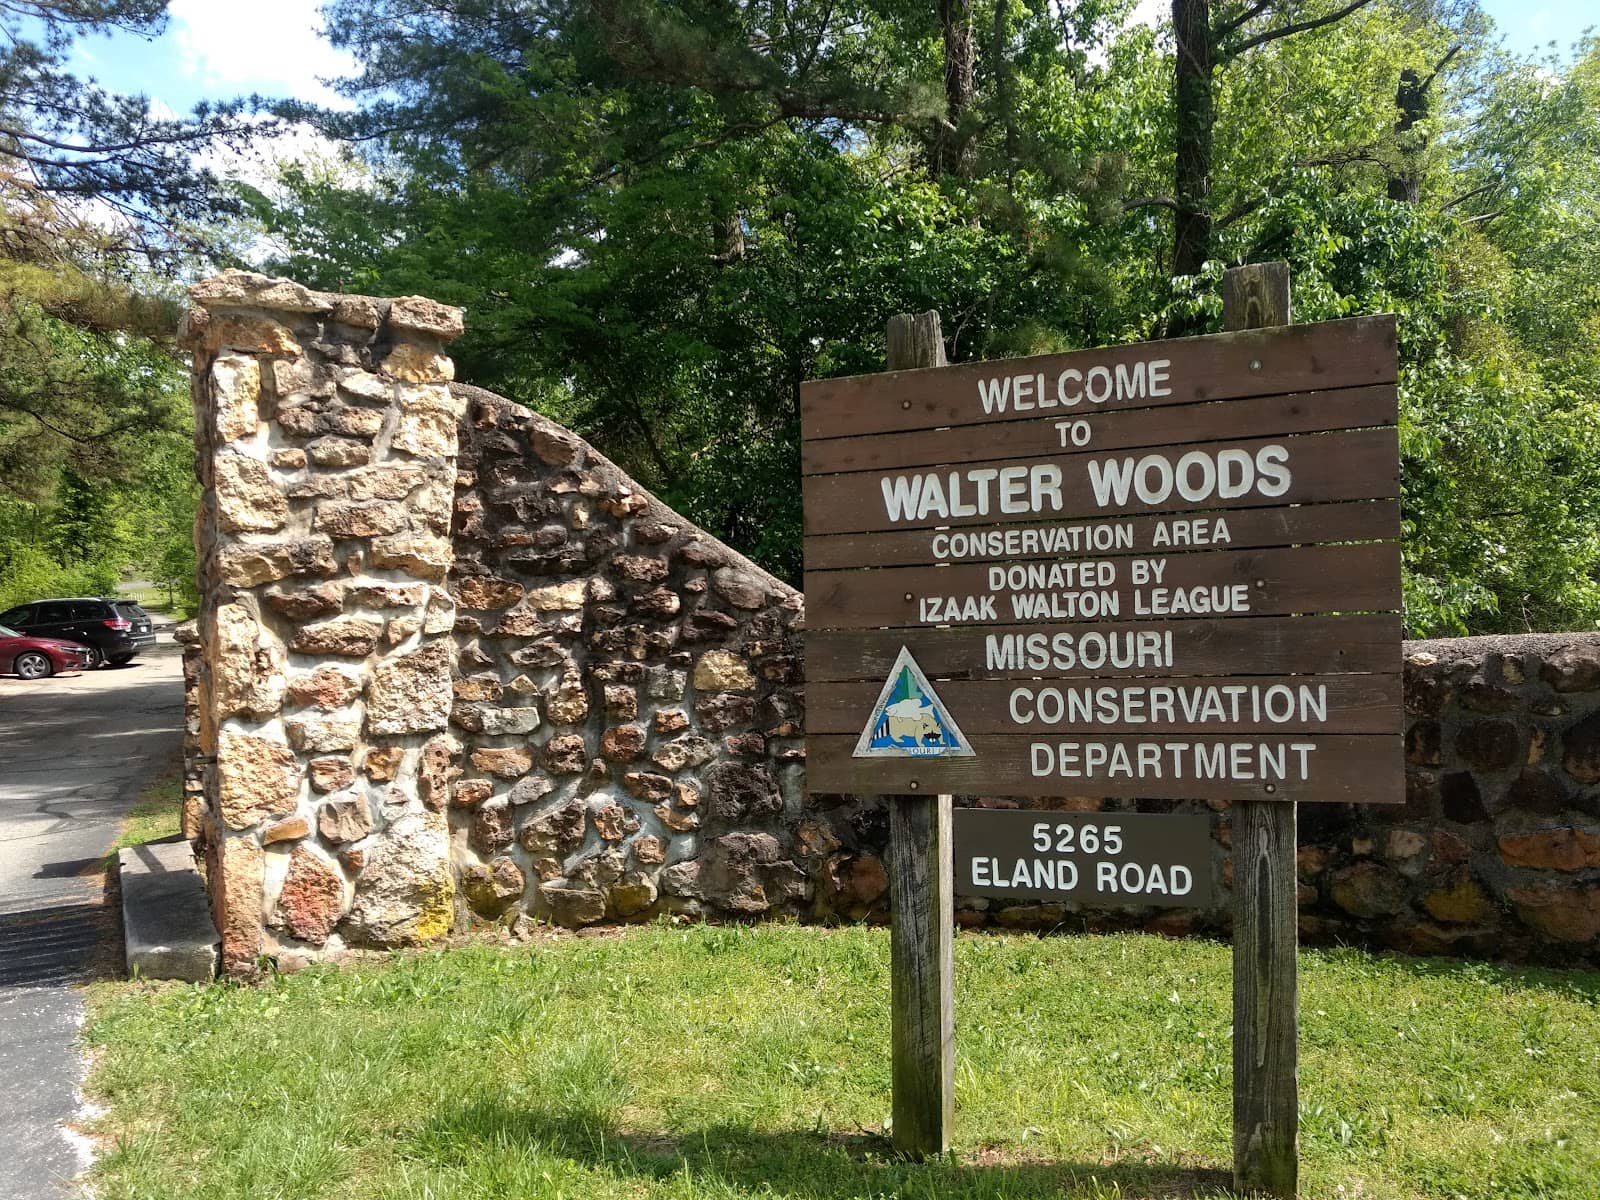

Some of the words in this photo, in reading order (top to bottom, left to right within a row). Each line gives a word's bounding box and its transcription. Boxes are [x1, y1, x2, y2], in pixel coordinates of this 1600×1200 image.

[978, 361, 1172, 413] WELCOME
[1055, 420, 1092, 448] TO
[881, 464, 1063, 521] WALTER
[1088, 445, 1292, 507] WOODS
[932, 524, 1134, 558] CONSERVATION
[1153, 518, 1231, 546] AREA
[989, 561, 1116, 591] DONATED
[1132, 559, 1167, 585] BY
[919, 595, 997, 623] IZAAK
[1012, 590, 1120, 619] WALTON
[1135, 585, 1250, 615] LEAGUE
[985, 630, 1173, 671] MISSOURI
[1010, 685, 1328, 724] CONSERVATION
[1031, 743, 1317, 780] DEPARTMENT
[1032, 823, 1123, 855] 5265
[972, 857, 1078, 892] ELAND
[1097, 862, 1193, 896] ROAD
